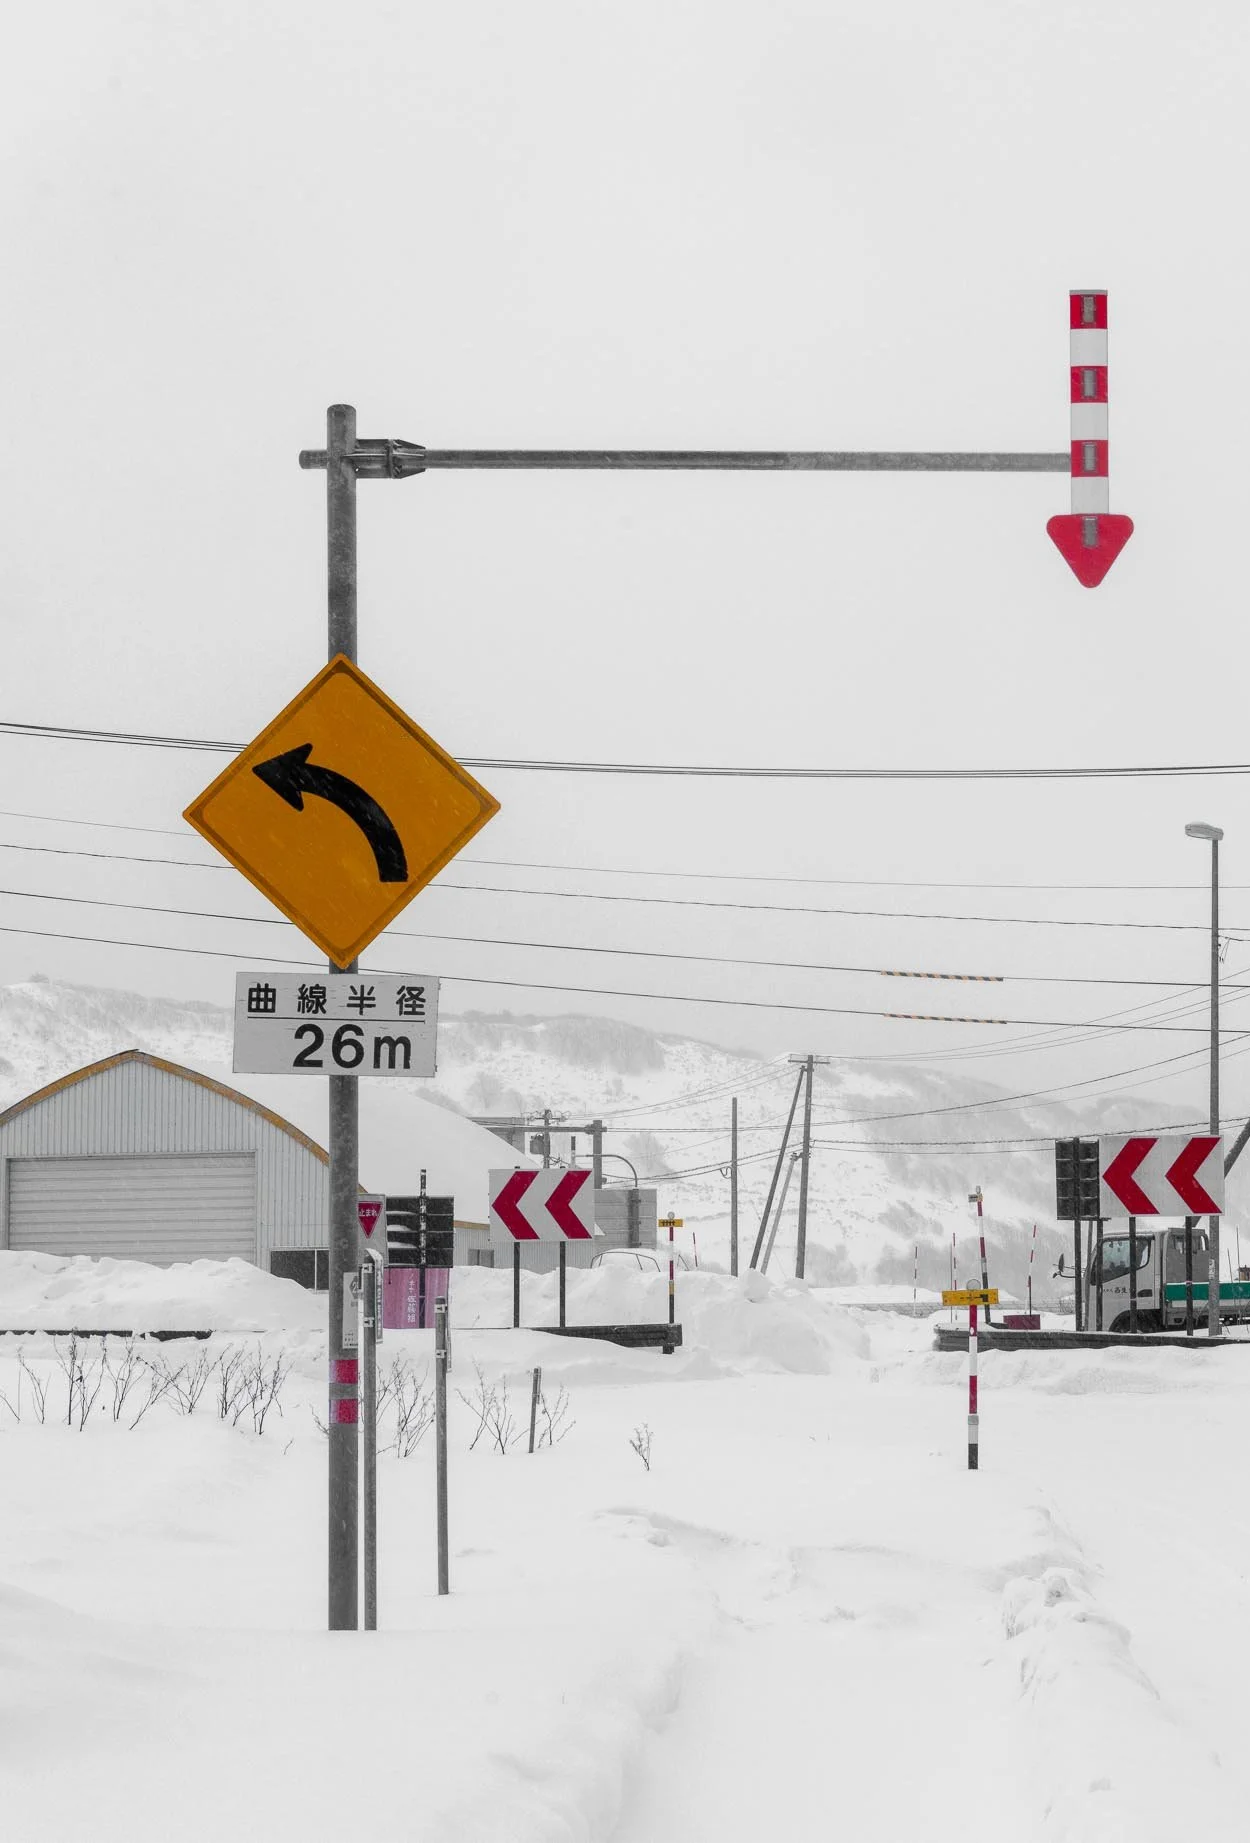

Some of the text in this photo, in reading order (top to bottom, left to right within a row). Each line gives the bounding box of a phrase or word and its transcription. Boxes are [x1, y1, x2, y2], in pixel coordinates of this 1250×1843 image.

[247, 983, 426, 1016] 曲線半径
[293, 1023, 412, 1069] 26m
